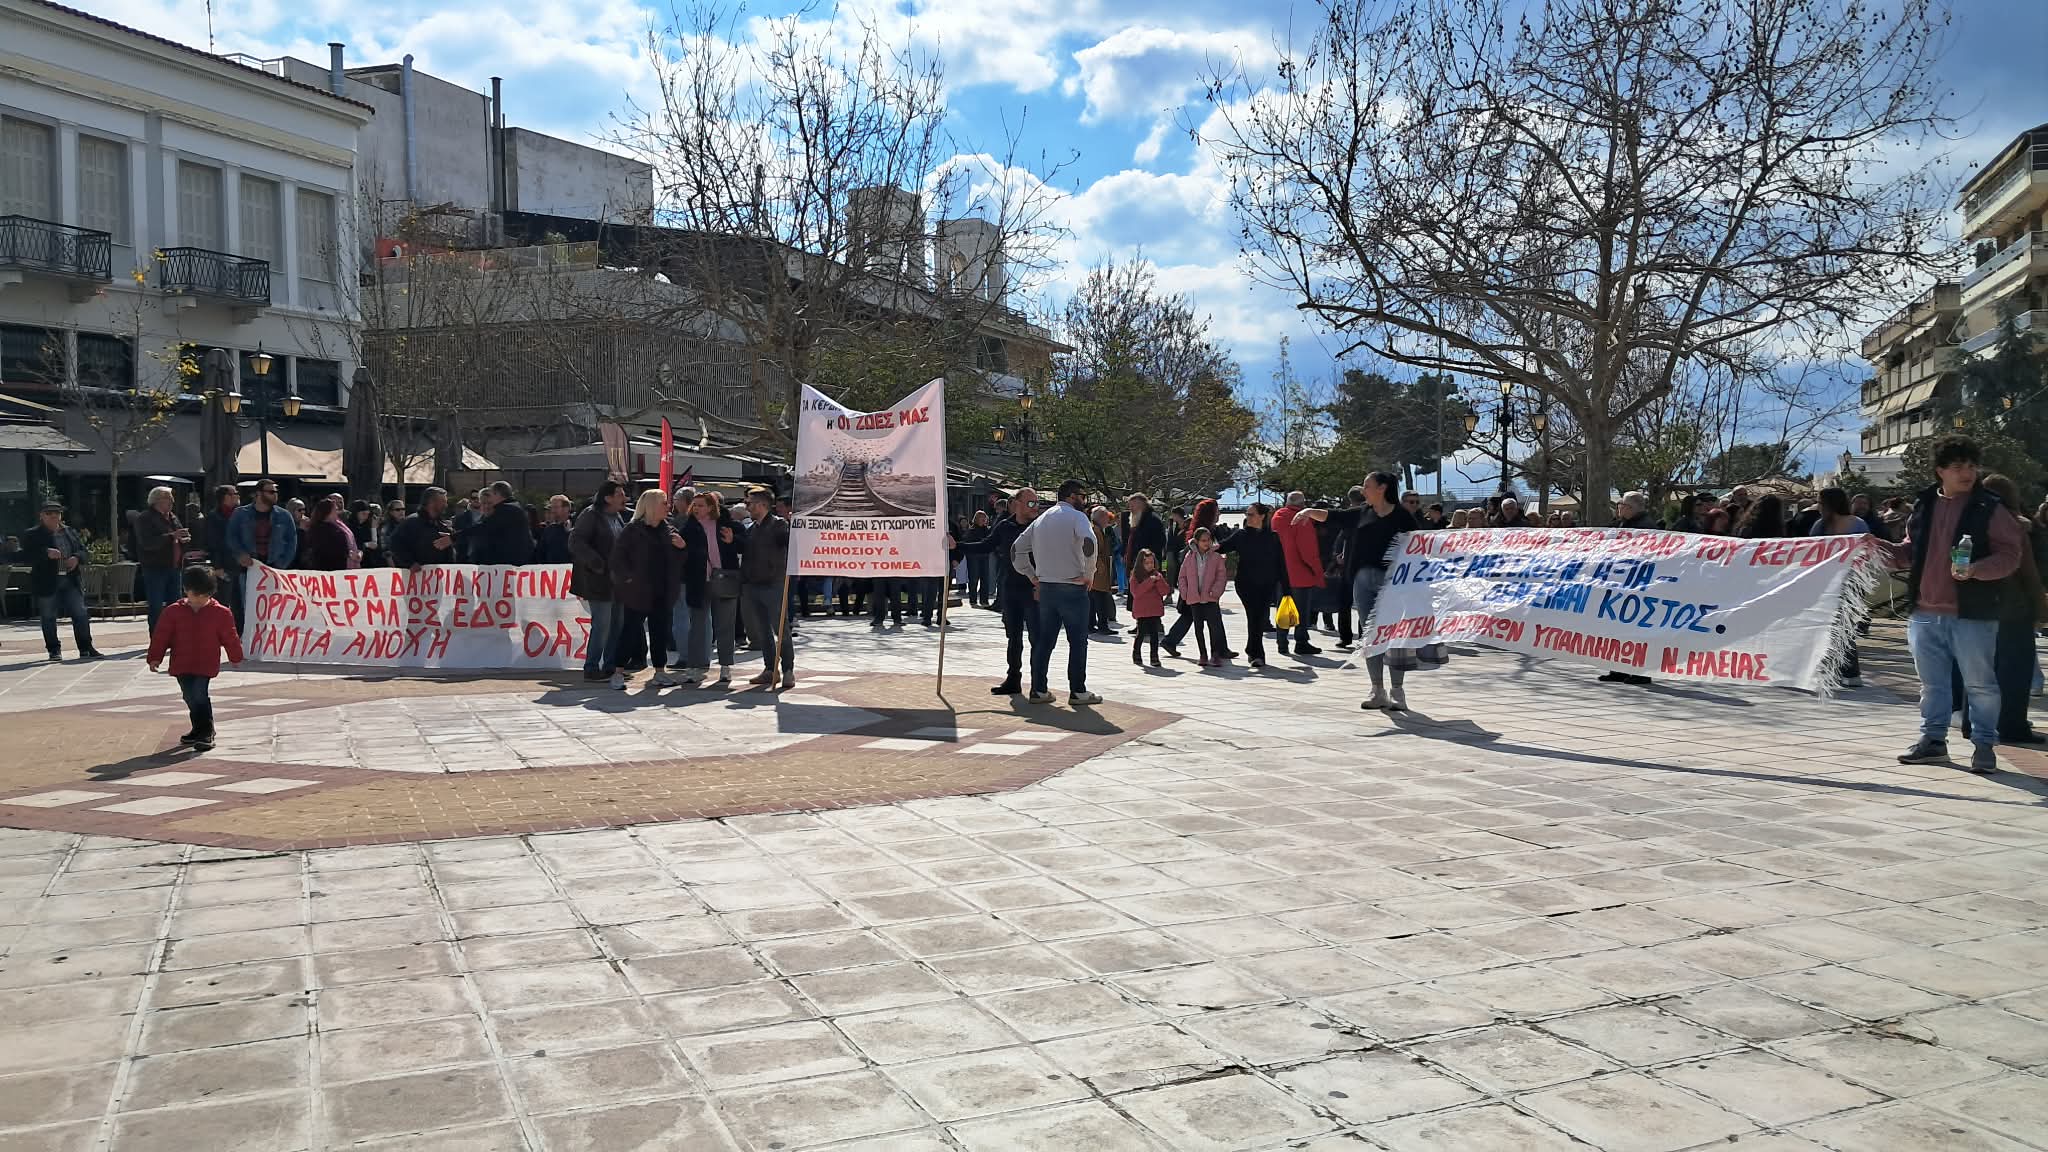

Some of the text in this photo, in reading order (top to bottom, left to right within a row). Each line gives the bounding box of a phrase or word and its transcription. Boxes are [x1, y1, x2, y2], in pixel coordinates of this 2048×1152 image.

[855, 412, 895, 431] ΖΩΕΣ
[900, 406, 930, 427] ΜΑΣ
[791, 518, 807, 529] ΔΕΝ
[808, 519, 844, 531] ΞΕΧΝΑΜΕ
[850, 519, 868, 531] ΔΕΝ
[871, 518, 936, 531] ΣΥΓΧΩΡΟΥΜΕ
[820, 531, 890, 542] ΣΩΜΑΤΕΙΑ
[813, 546, 900, 556] ΔΗΜΟΣΙΟΥ &
[1405, 533, 1436, 556] ΟΧΙ
[1696, 537, 1747, 567] ΤΟΥ
[800, 559, 922, 571] ΙΔΙΩΤΙΚΟΥ ΤΟΜΕΑ
[1392, 562, 1410, 586] ΟΙ
[344, 574, 380, 599] ΤΑ
[390, 567, 465, 597] ΔΑΚΡΙΑ
[453, 598, 519, 629] ΕΔΩ
[1597, 589, 1727, 635] ΚΟΣΤΟΣ.
[249, 623, 333, 657] ΚΑΜΙΑ
[341, 627, 452, 660] ΑΝΟΧΗ
